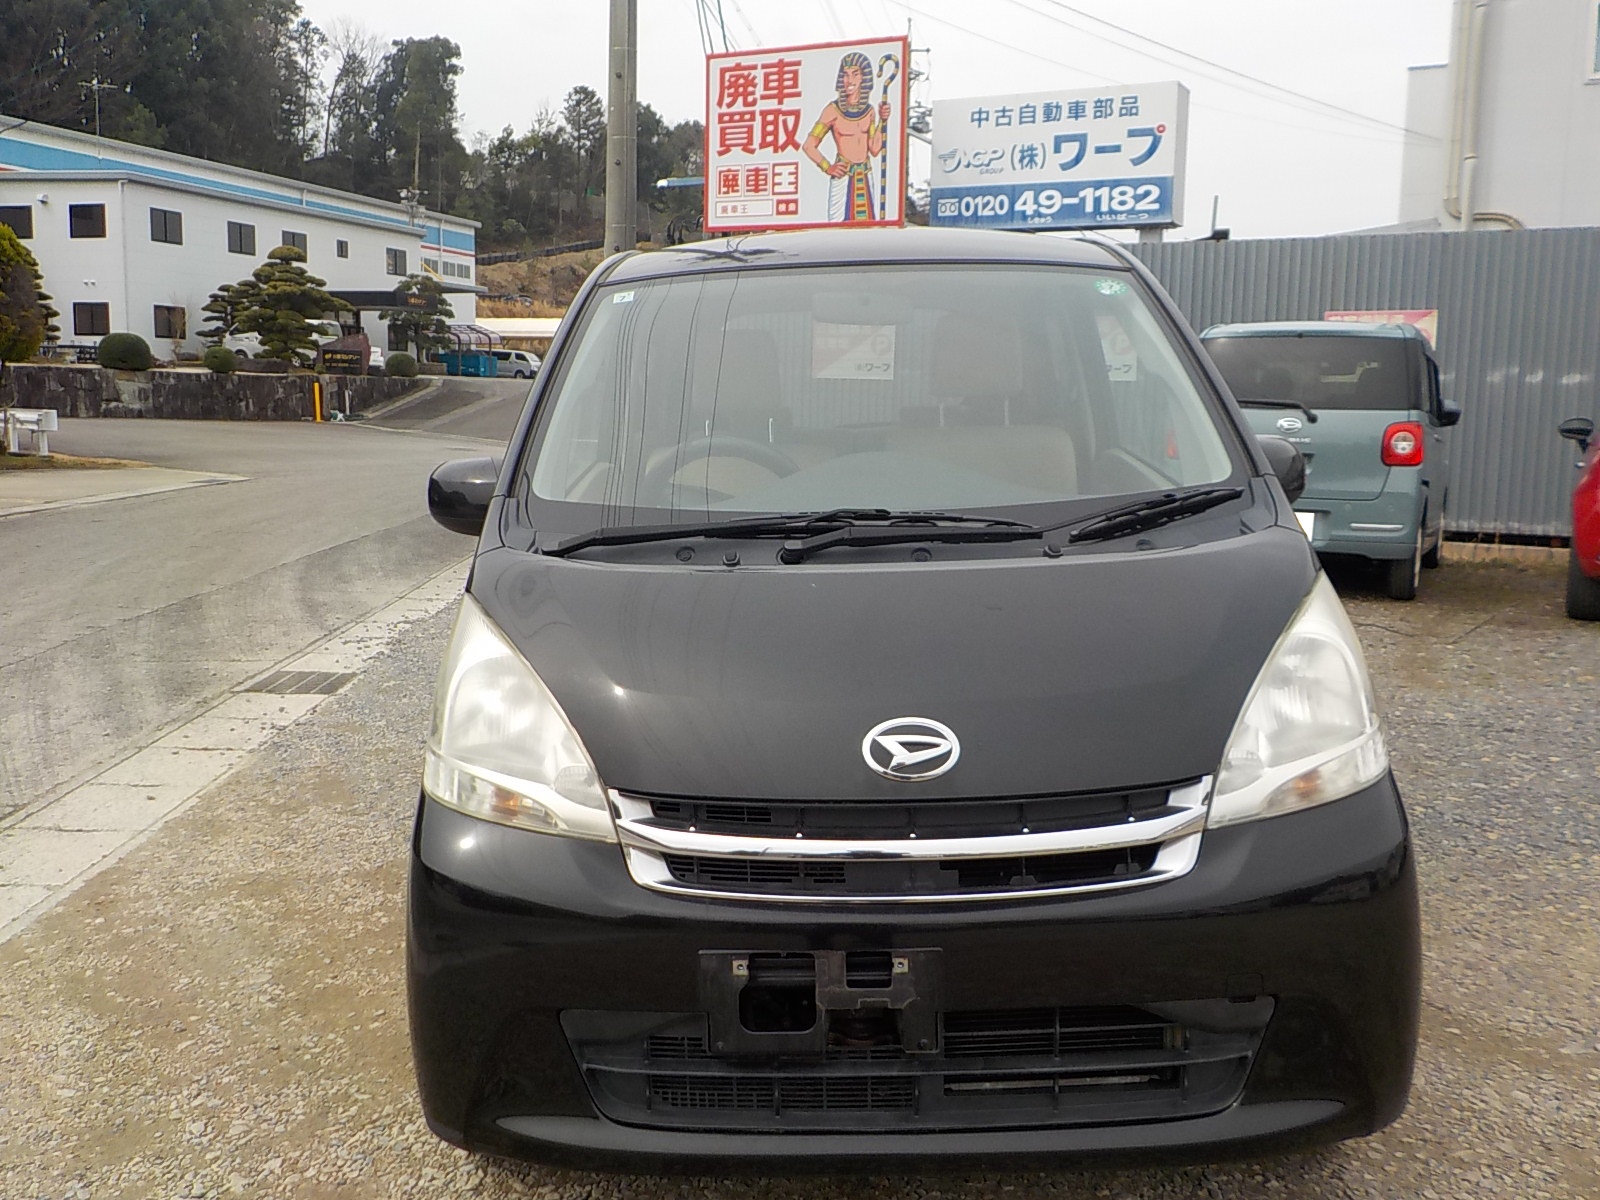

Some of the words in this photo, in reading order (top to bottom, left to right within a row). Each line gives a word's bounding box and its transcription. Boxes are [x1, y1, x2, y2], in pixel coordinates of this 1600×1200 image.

[716, 58, 802, 109] 廃車
[970, 95, 1140, 128] 中古自動車部品
[716, 108, 801, 157] 買取
[717, 162, 799, 196] 廃車王
[961, 195, 1009, 217] 0120
[1014, 184, 1161, 216] 49-1182
